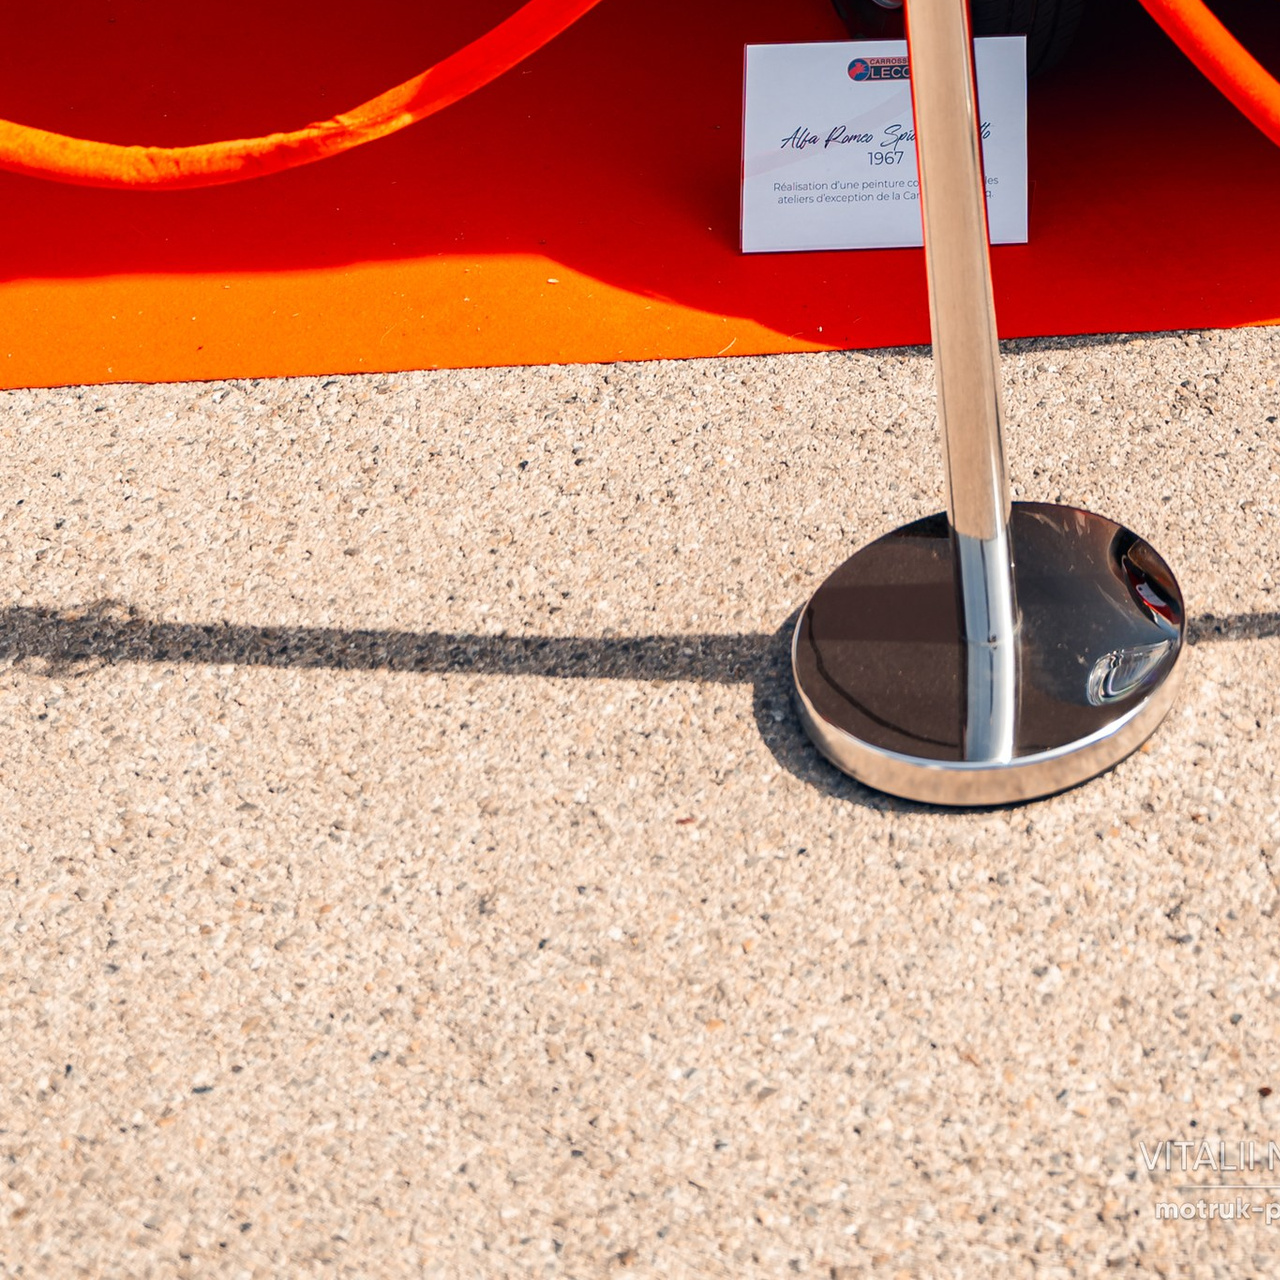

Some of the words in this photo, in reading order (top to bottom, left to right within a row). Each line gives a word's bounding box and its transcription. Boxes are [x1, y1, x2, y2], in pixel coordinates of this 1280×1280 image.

[870, 57, 907, 65] CARROSS
[871, 66, 910, 79] LECO
[780, 126, 820, 150] Alfa
[824, 125, 873, 149] Romeo
[880, 124, 916, 151] Spi
[867, 151, 905, 166] 1967
[773, 181, 829, 192] Réalisation
[861, 178, 905, 190] peinture
[778, 192, 815, 205] ateliers
[876, 190, 890, 201] de
[892, 191, 901, 201] la
